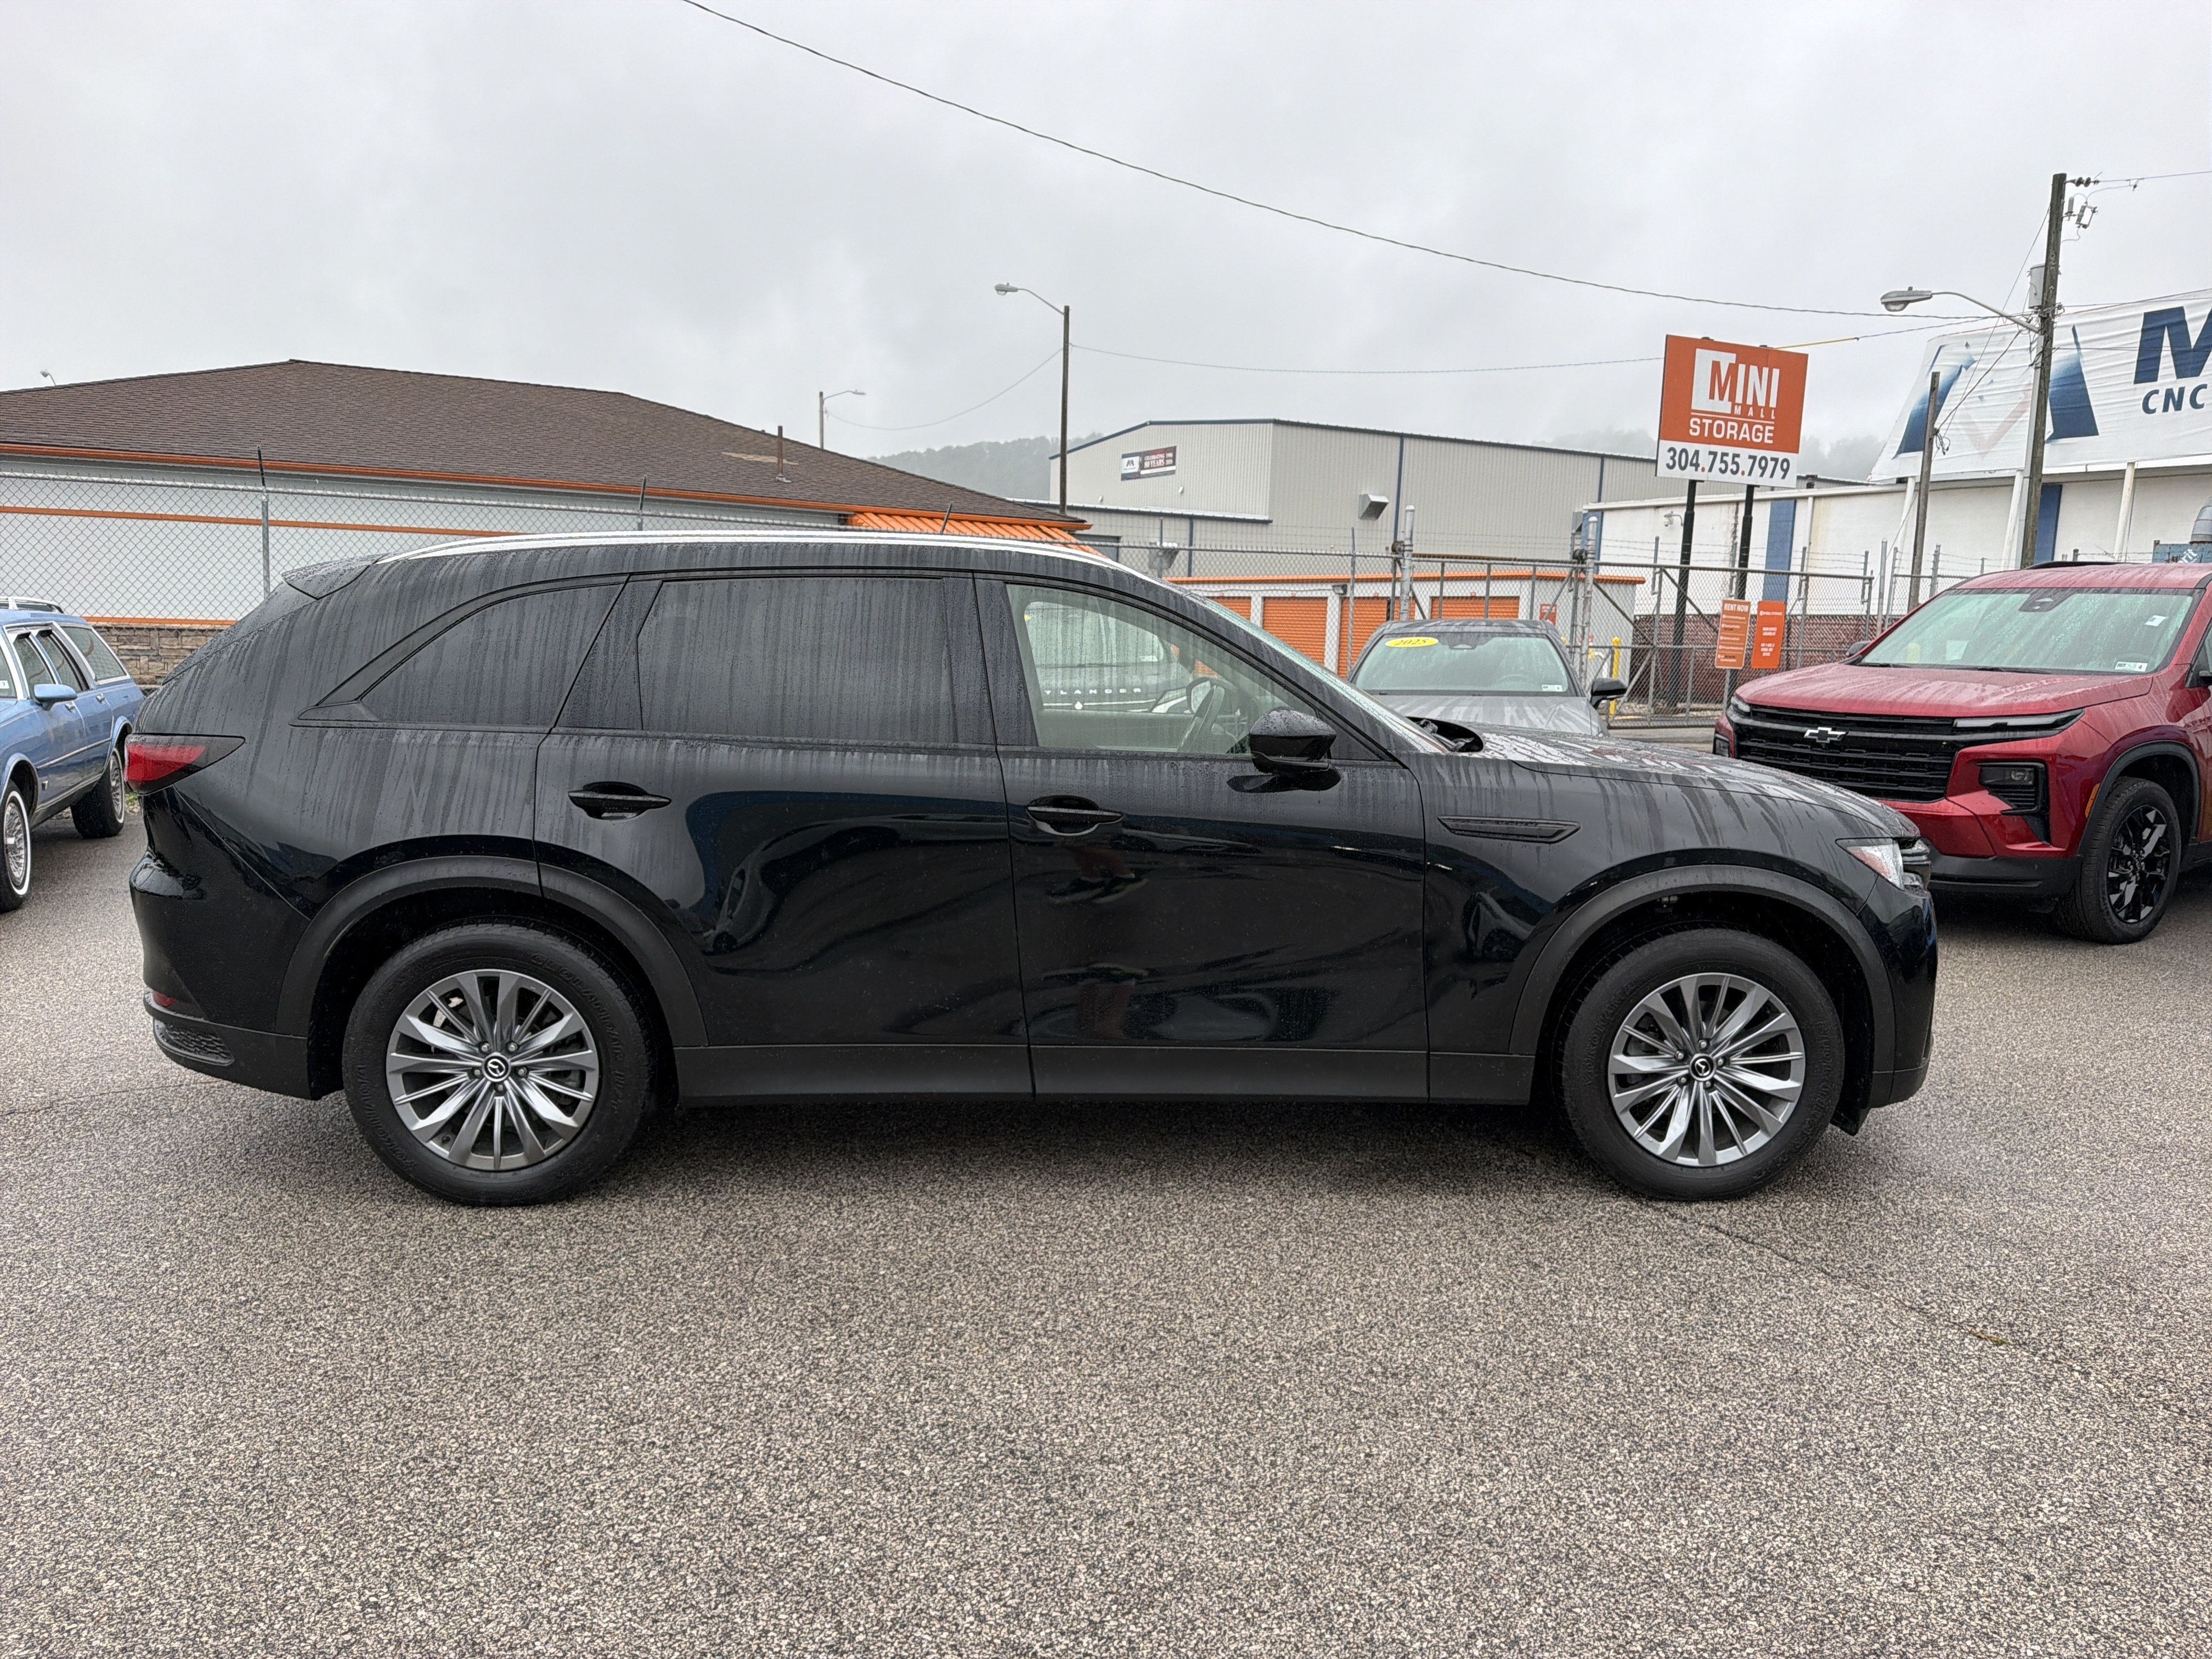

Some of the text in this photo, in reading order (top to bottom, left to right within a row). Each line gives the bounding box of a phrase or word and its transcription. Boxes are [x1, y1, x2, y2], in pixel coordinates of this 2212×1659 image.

[1703, 357, 1780, 409] MINI
[1734, 404, 1775, 419] MALL
[2142, 383, 2208, 414] CNC
[1689, 417, 1775, 444] STORAGE
[1666, 447, 1790, 479] 304.755.7979
[1724, 603, 1749, 612] RENT NOW
